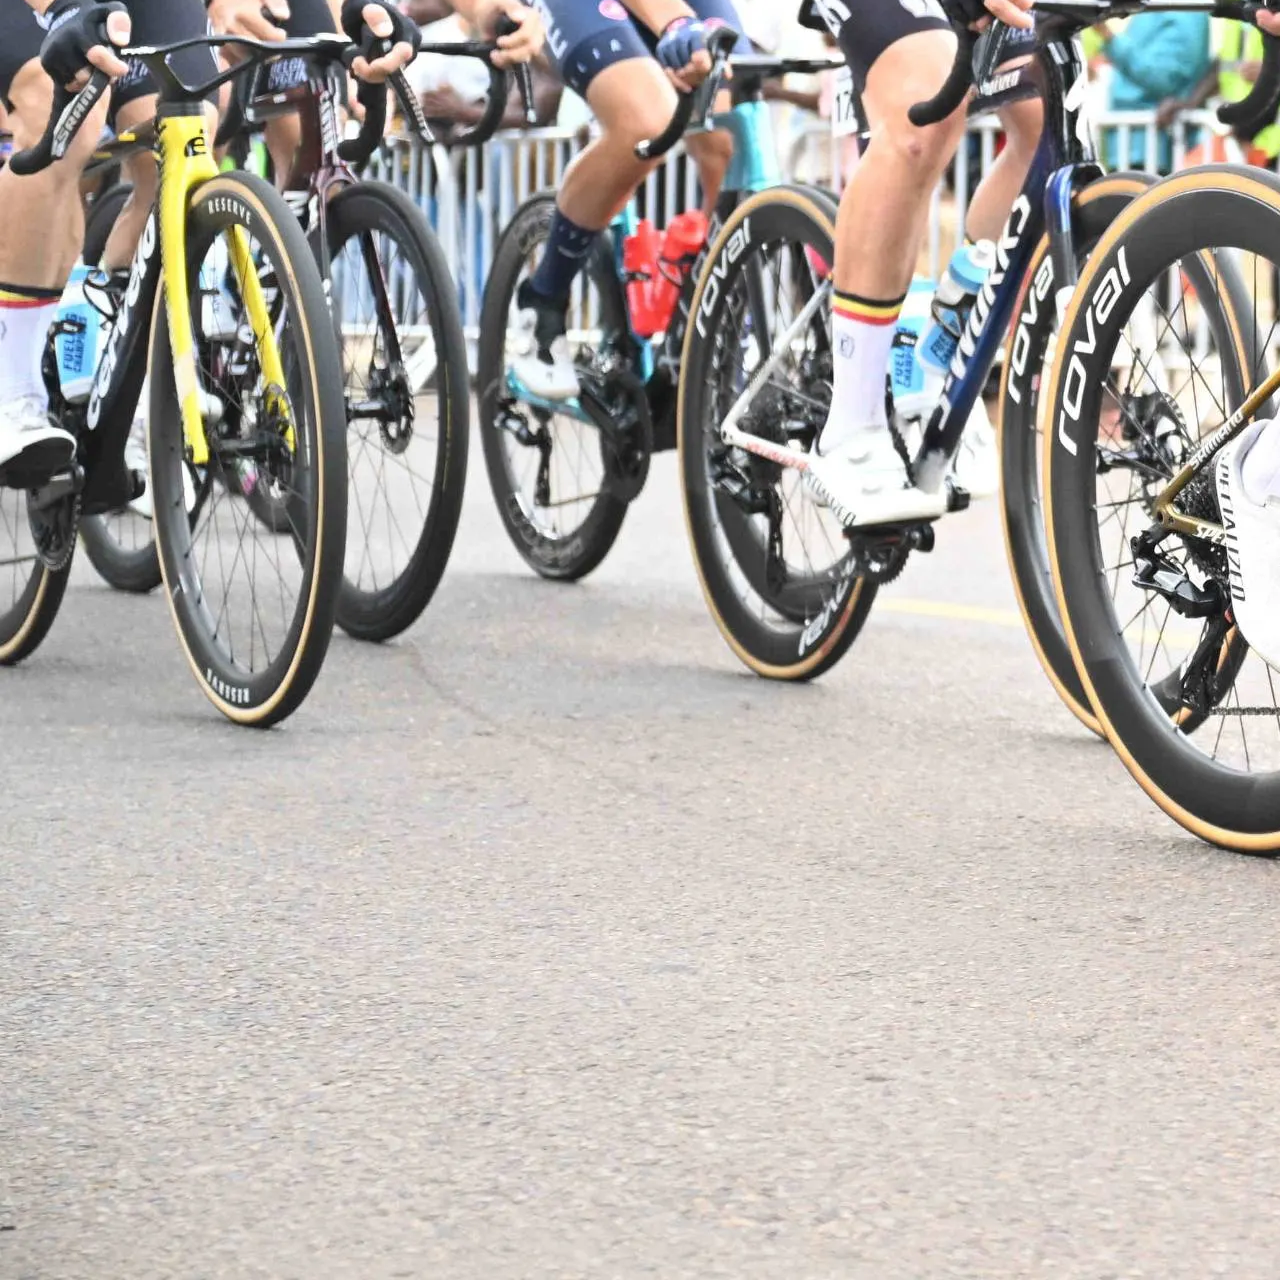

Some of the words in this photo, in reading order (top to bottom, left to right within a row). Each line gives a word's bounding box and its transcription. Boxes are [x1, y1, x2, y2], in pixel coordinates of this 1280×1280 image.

[208, 198, 251, 225] RESERVE
[696, 216, 750, 337] roval
[1008, 255, 1054, 404] rova
[1058, 245, 1131, 456] roval
